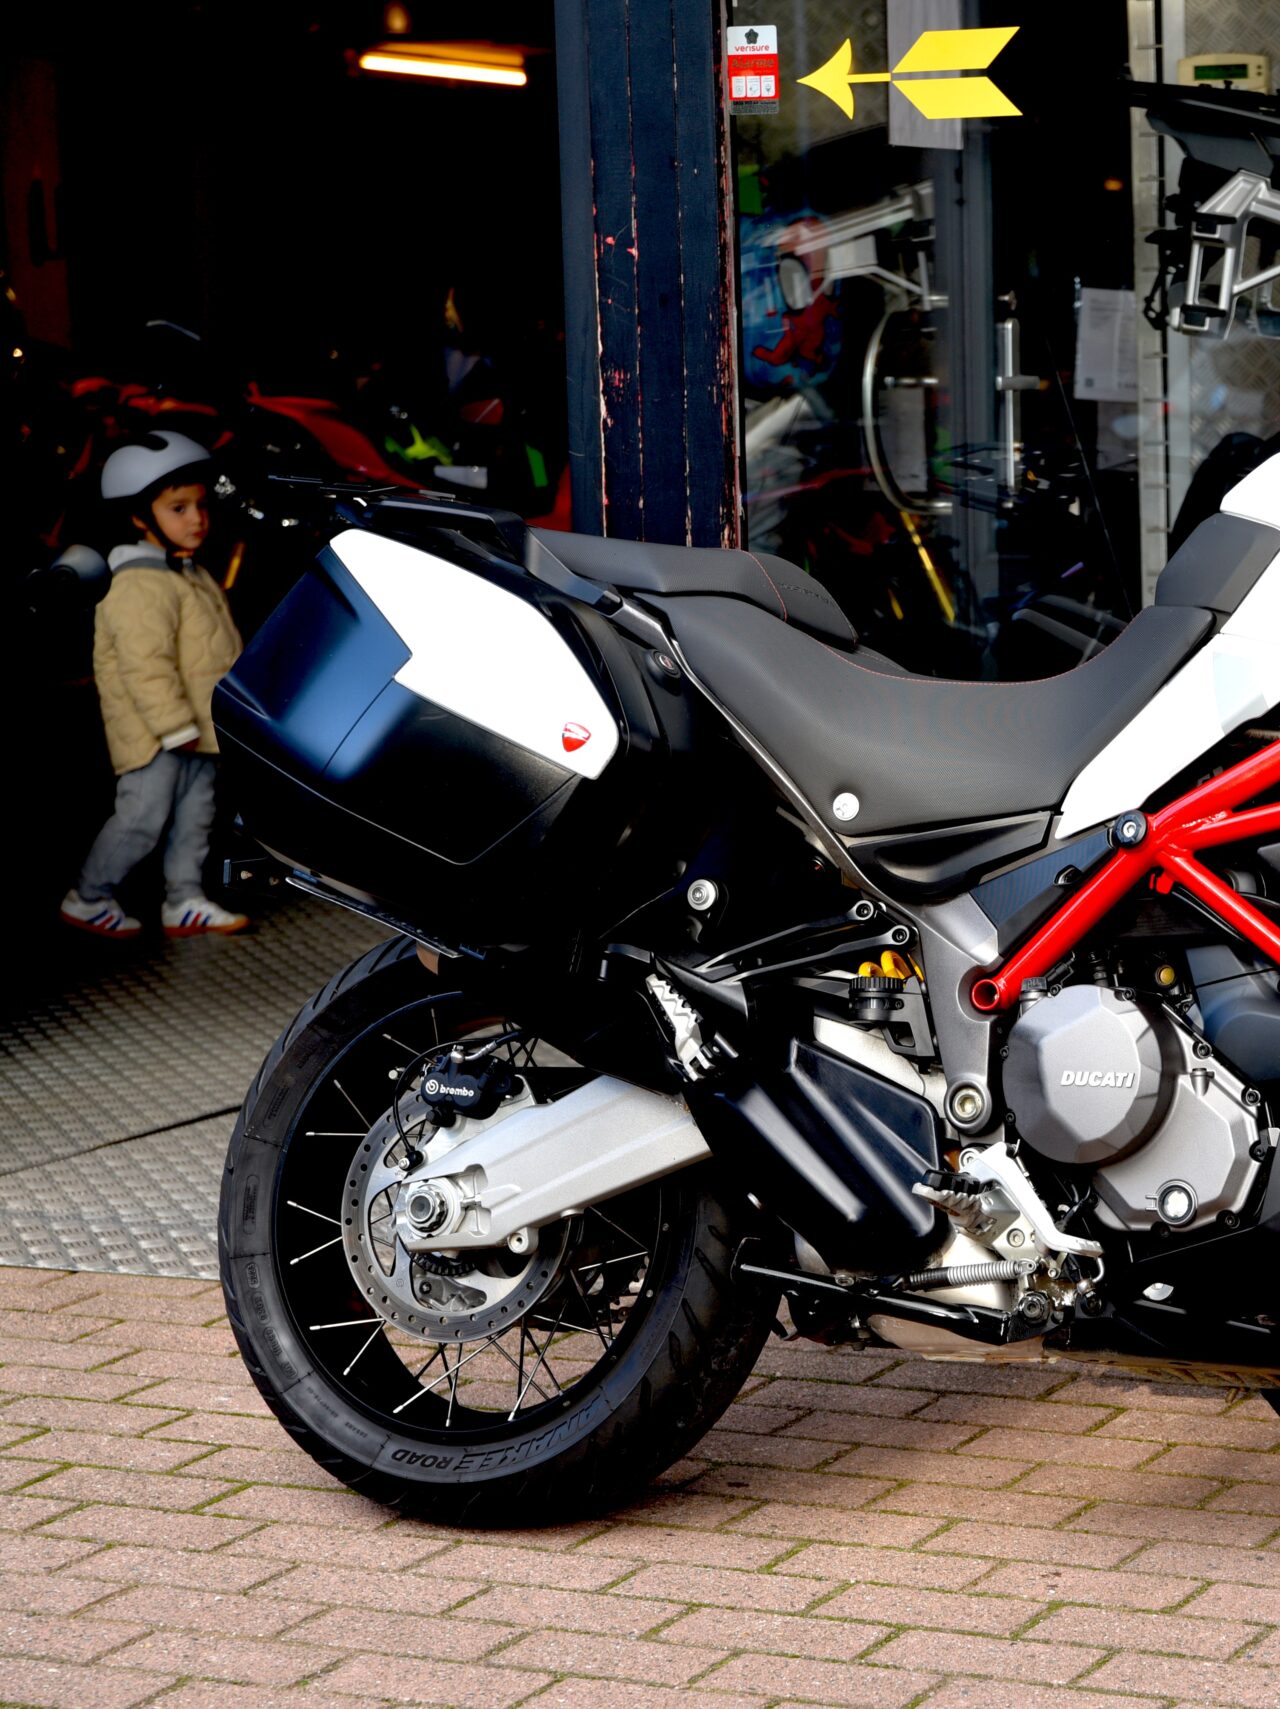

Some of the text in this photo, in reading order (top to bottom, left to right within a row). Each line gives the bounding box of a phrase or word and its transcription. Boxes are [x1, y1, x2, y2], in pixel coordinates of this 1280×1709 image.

[734, 44, 770, 52] verisure
[1060, 1070, 1136, 1089] DUCATI
[439, 1083, 475, 1098] brembo
[390, 1393, 603, 1472] ANAKEE ROAD
